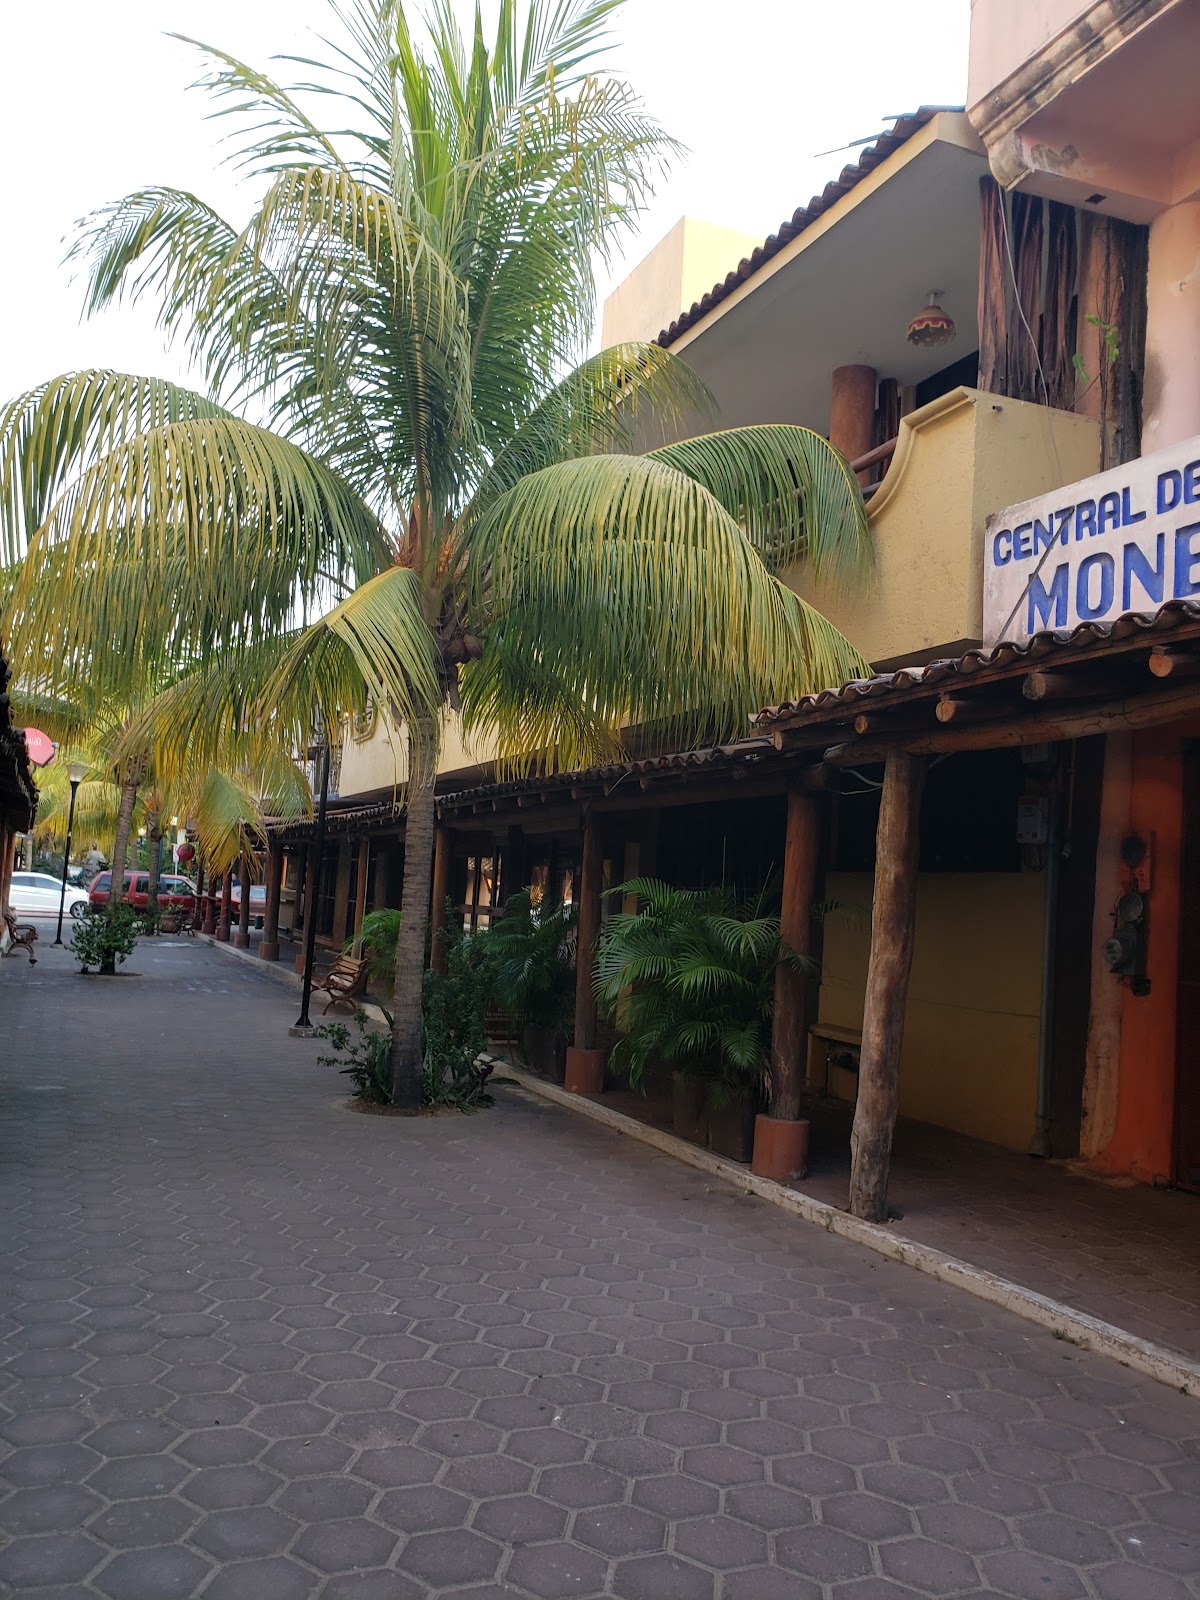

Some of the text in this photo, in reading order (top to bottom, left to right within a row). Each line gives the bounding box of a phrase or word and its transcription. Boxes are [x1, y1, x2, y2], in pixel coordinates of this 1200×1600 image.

[993, 459, 1200, 567] CENTRAL DE
[1027, 522, 1200, 635] MONE
